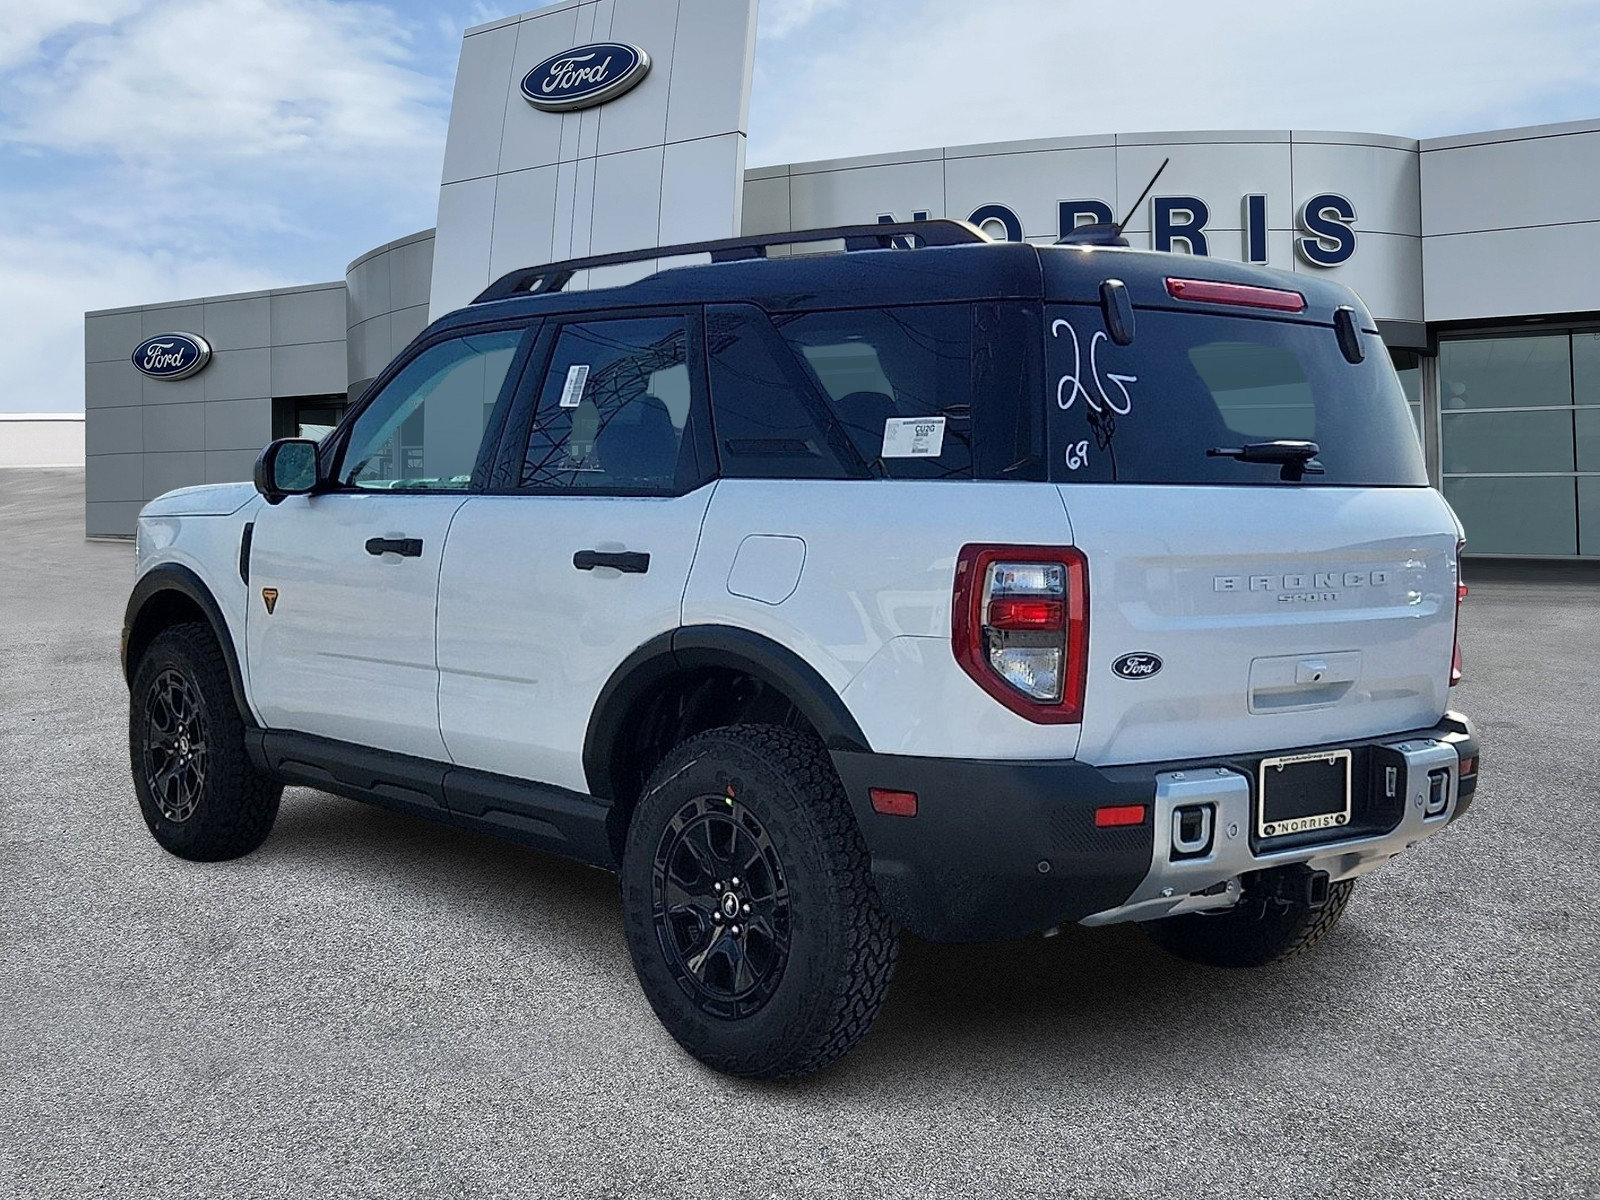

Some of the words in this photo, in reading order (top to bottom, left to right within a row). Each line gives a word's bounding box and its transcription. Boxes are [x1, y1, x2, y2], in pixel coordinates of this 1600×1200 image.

[542, 53, 612, 93] Ford
[144, 343, 184, 369] Ford
[1065, 440, 1089, 470] 69
[1213, 571, 1390, 592] BRONCO
[1278, 592, 1340, 602] SPORT
[1123, 657, 1155, 674] Ford
[1281, 816, 1330, 832] NORRIS
